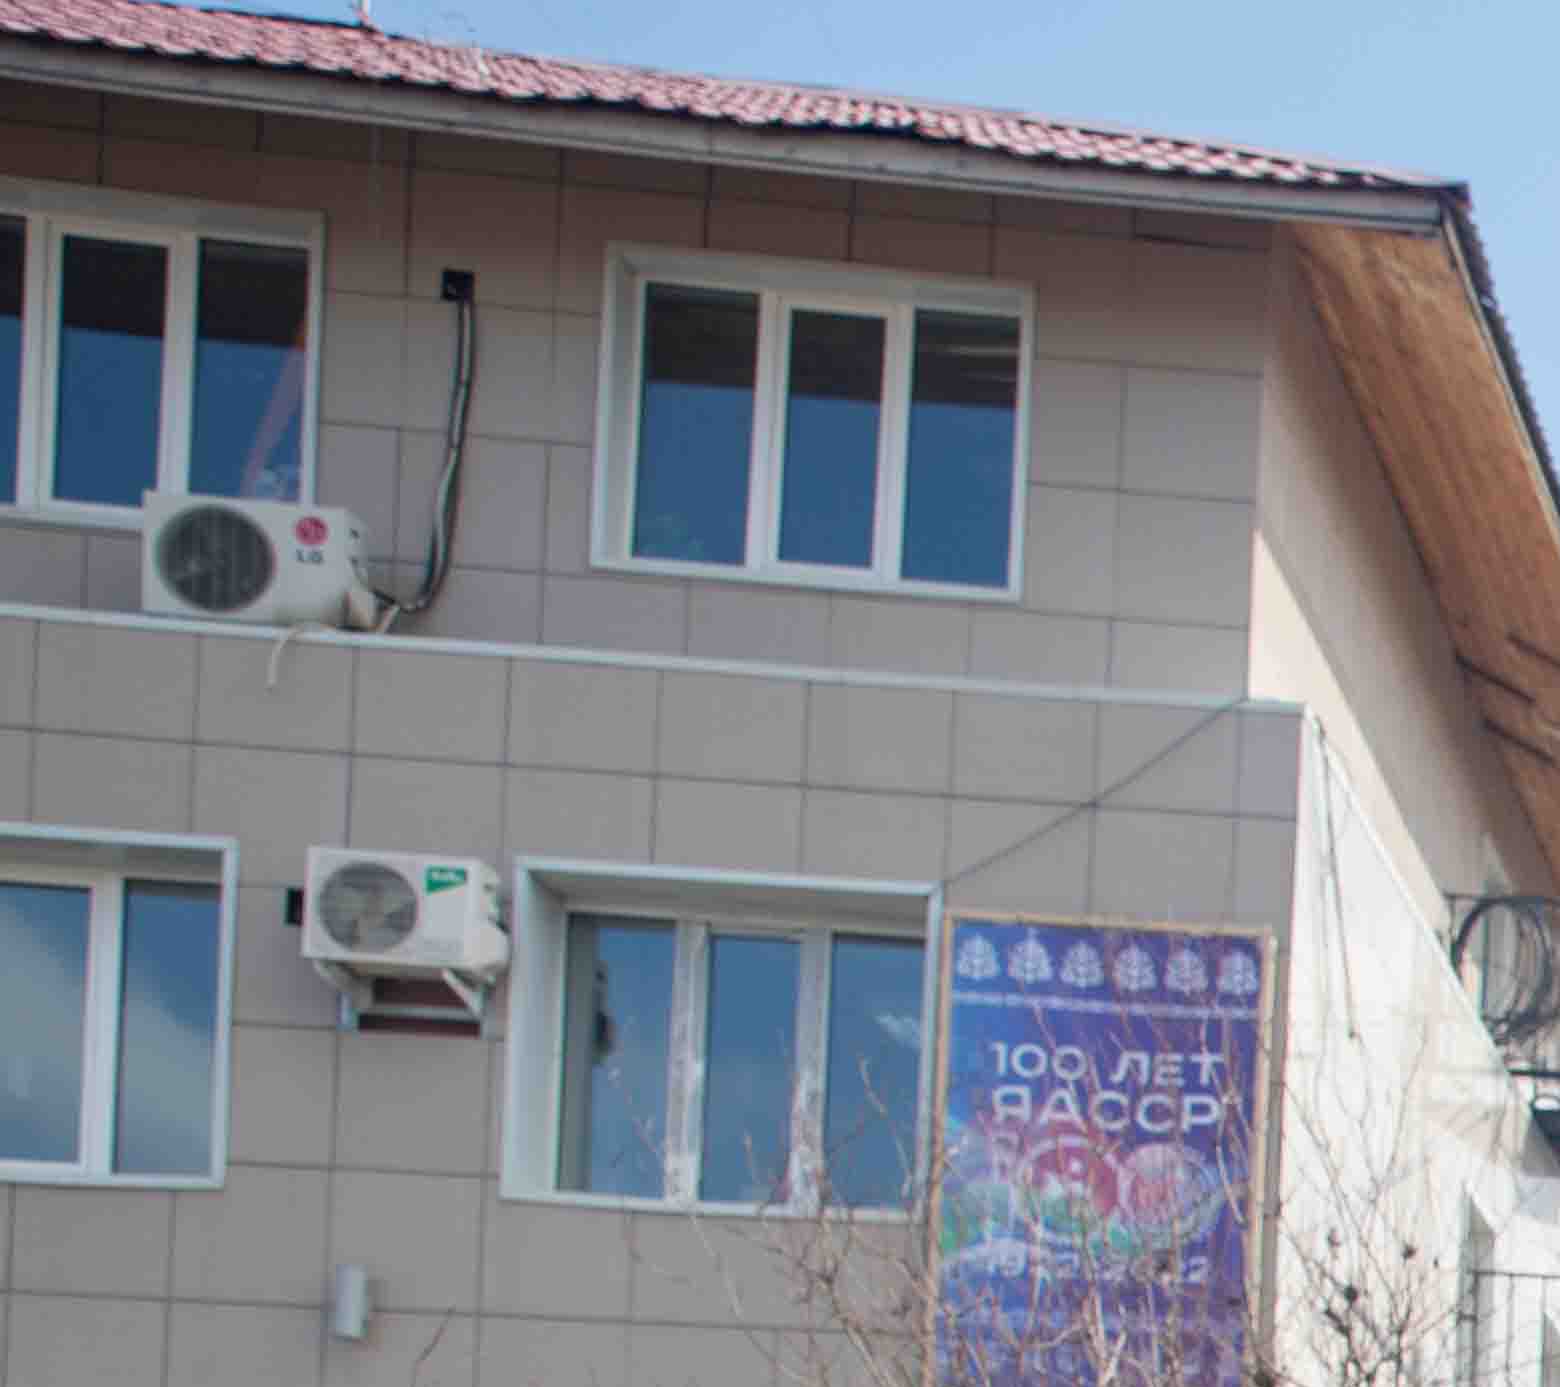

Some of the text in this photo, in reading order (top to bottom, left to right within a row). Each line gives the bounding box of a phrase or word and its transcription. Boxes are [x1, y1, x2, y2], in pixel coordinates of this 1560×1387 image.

[991, 1042, 1224, 1087] 100 ЛЕТ
[992, 1084, 1222, 1133] ЯАССР
